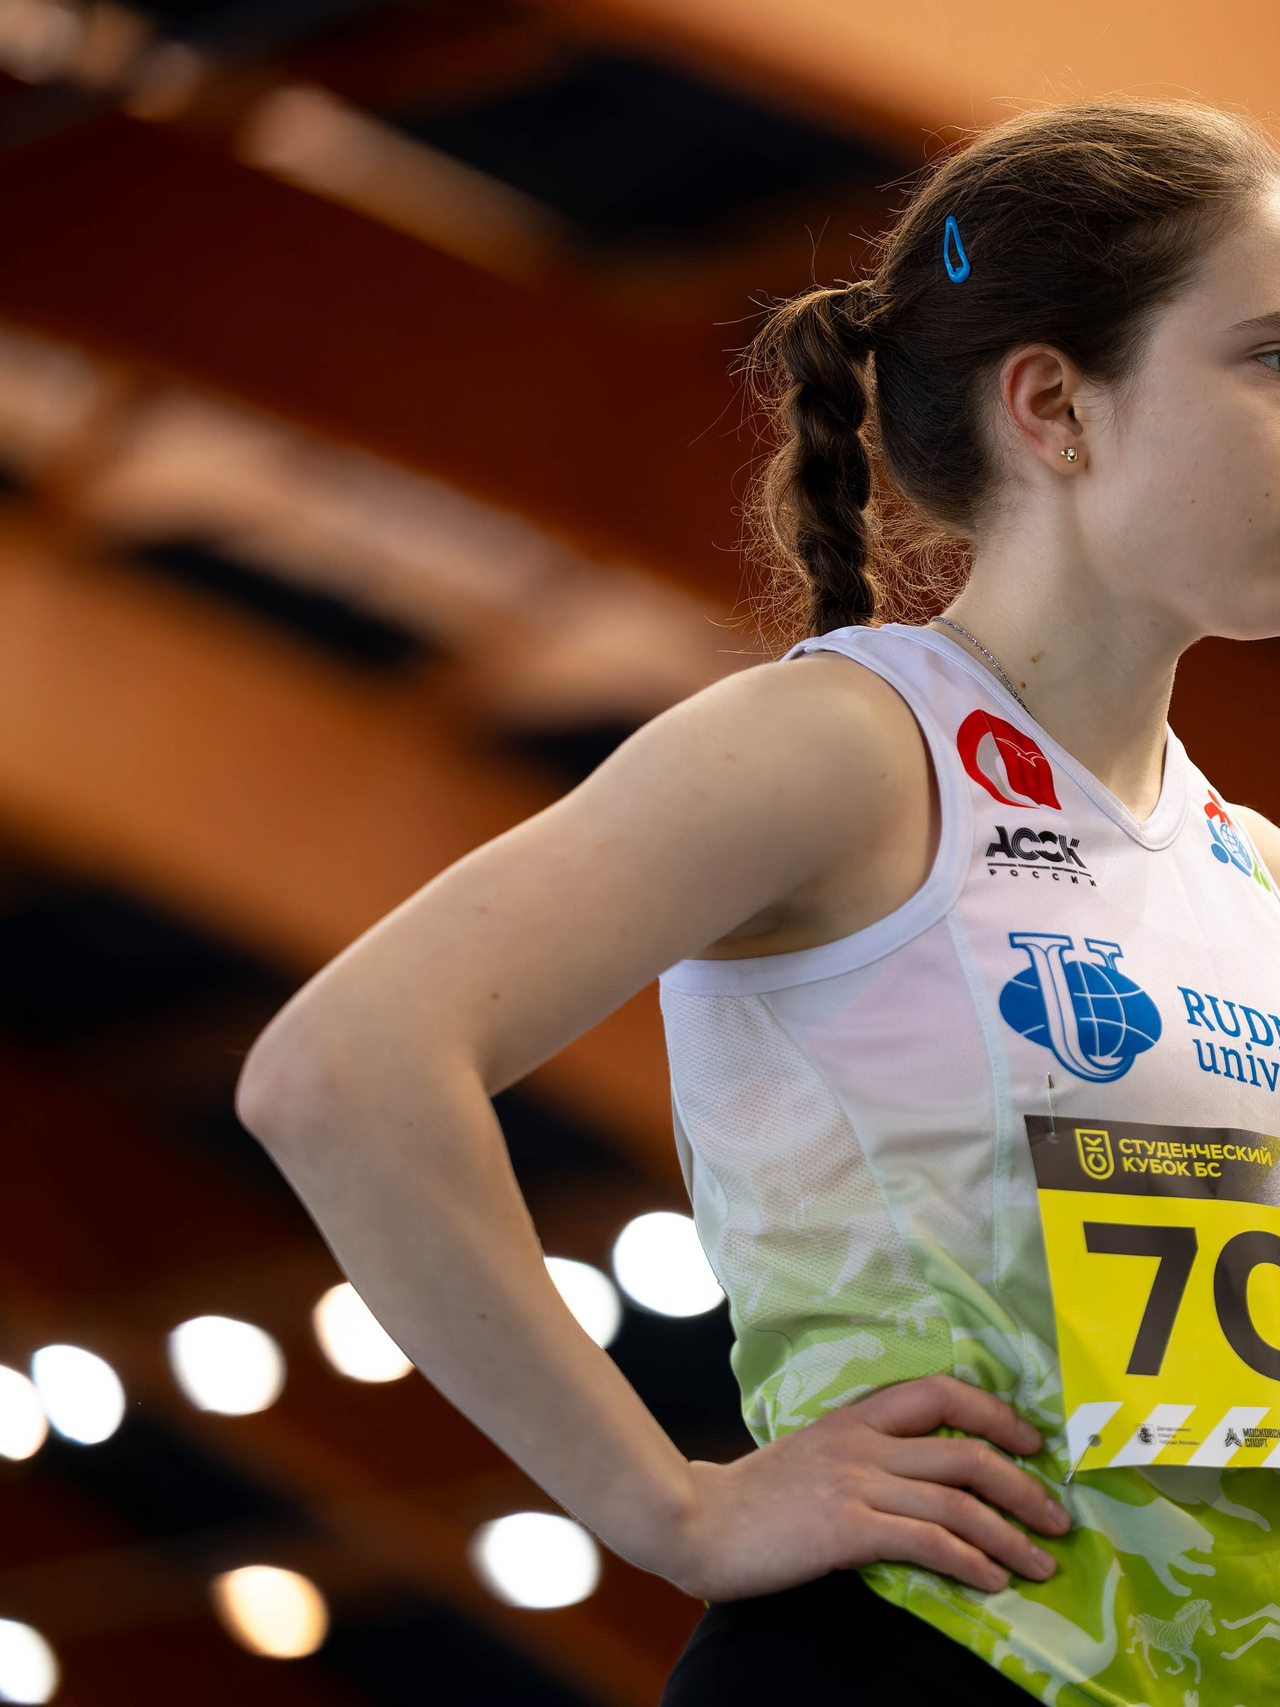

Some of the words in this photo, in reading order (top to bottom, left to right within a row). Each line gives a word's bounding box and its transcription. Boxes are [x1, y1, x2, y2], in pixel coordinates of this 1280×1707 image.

[989, 868, 1097, 887] РОССИИ
[1118, 1138, 1273, 1167] СТУДЕНЧЕСКИЙ
[1122, 1156, 1191, 1177] КУБОК
[1194, 1161, 1222, 1178] БС
